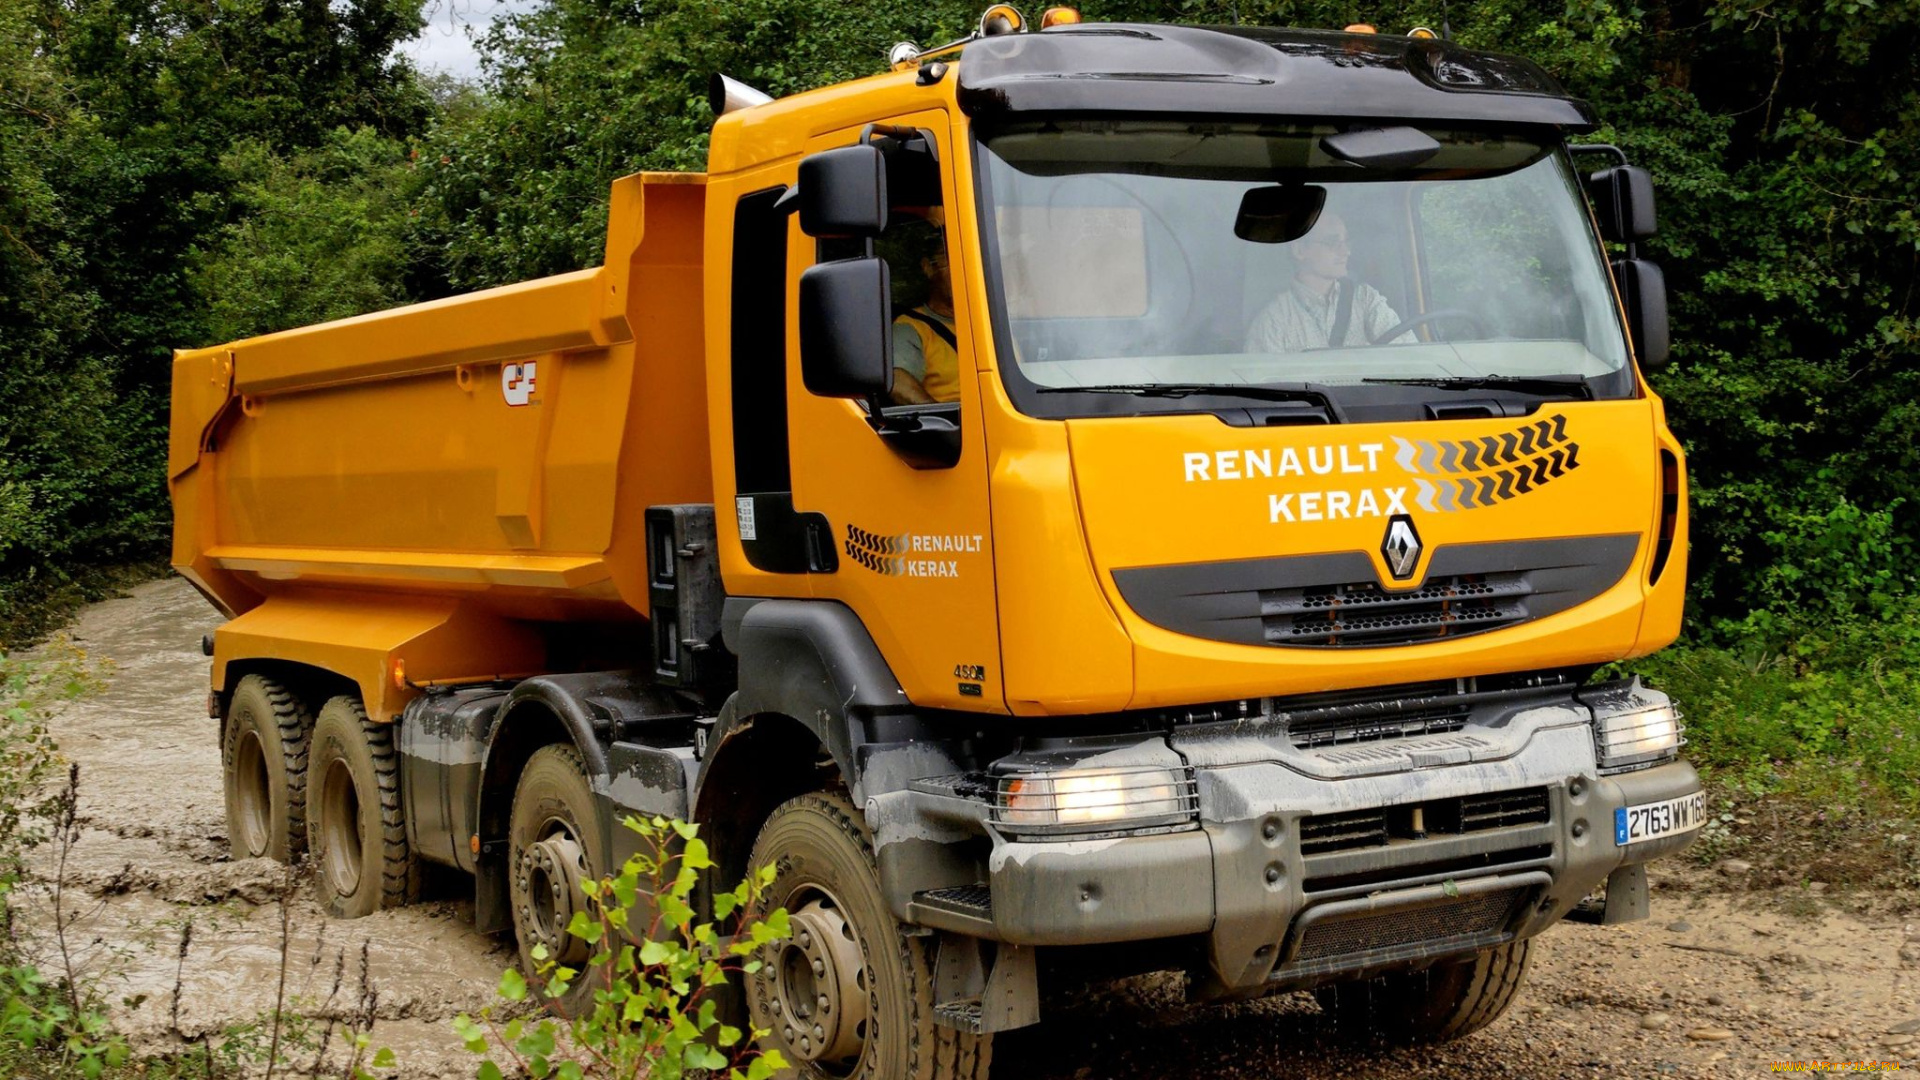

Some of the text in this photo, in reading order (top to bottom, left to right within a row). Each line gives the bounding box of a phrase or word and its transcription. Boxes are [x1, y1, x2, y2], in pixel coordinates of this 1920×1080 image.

[1183, 443, 1384, 482] RENAULT
[1268, 486, 1409, 523] KERAX
[912, 535, 983, 552] RENAULT
[908, 560, 959, 577] KERAX
[1629, 804, 1671, 838] 2763
